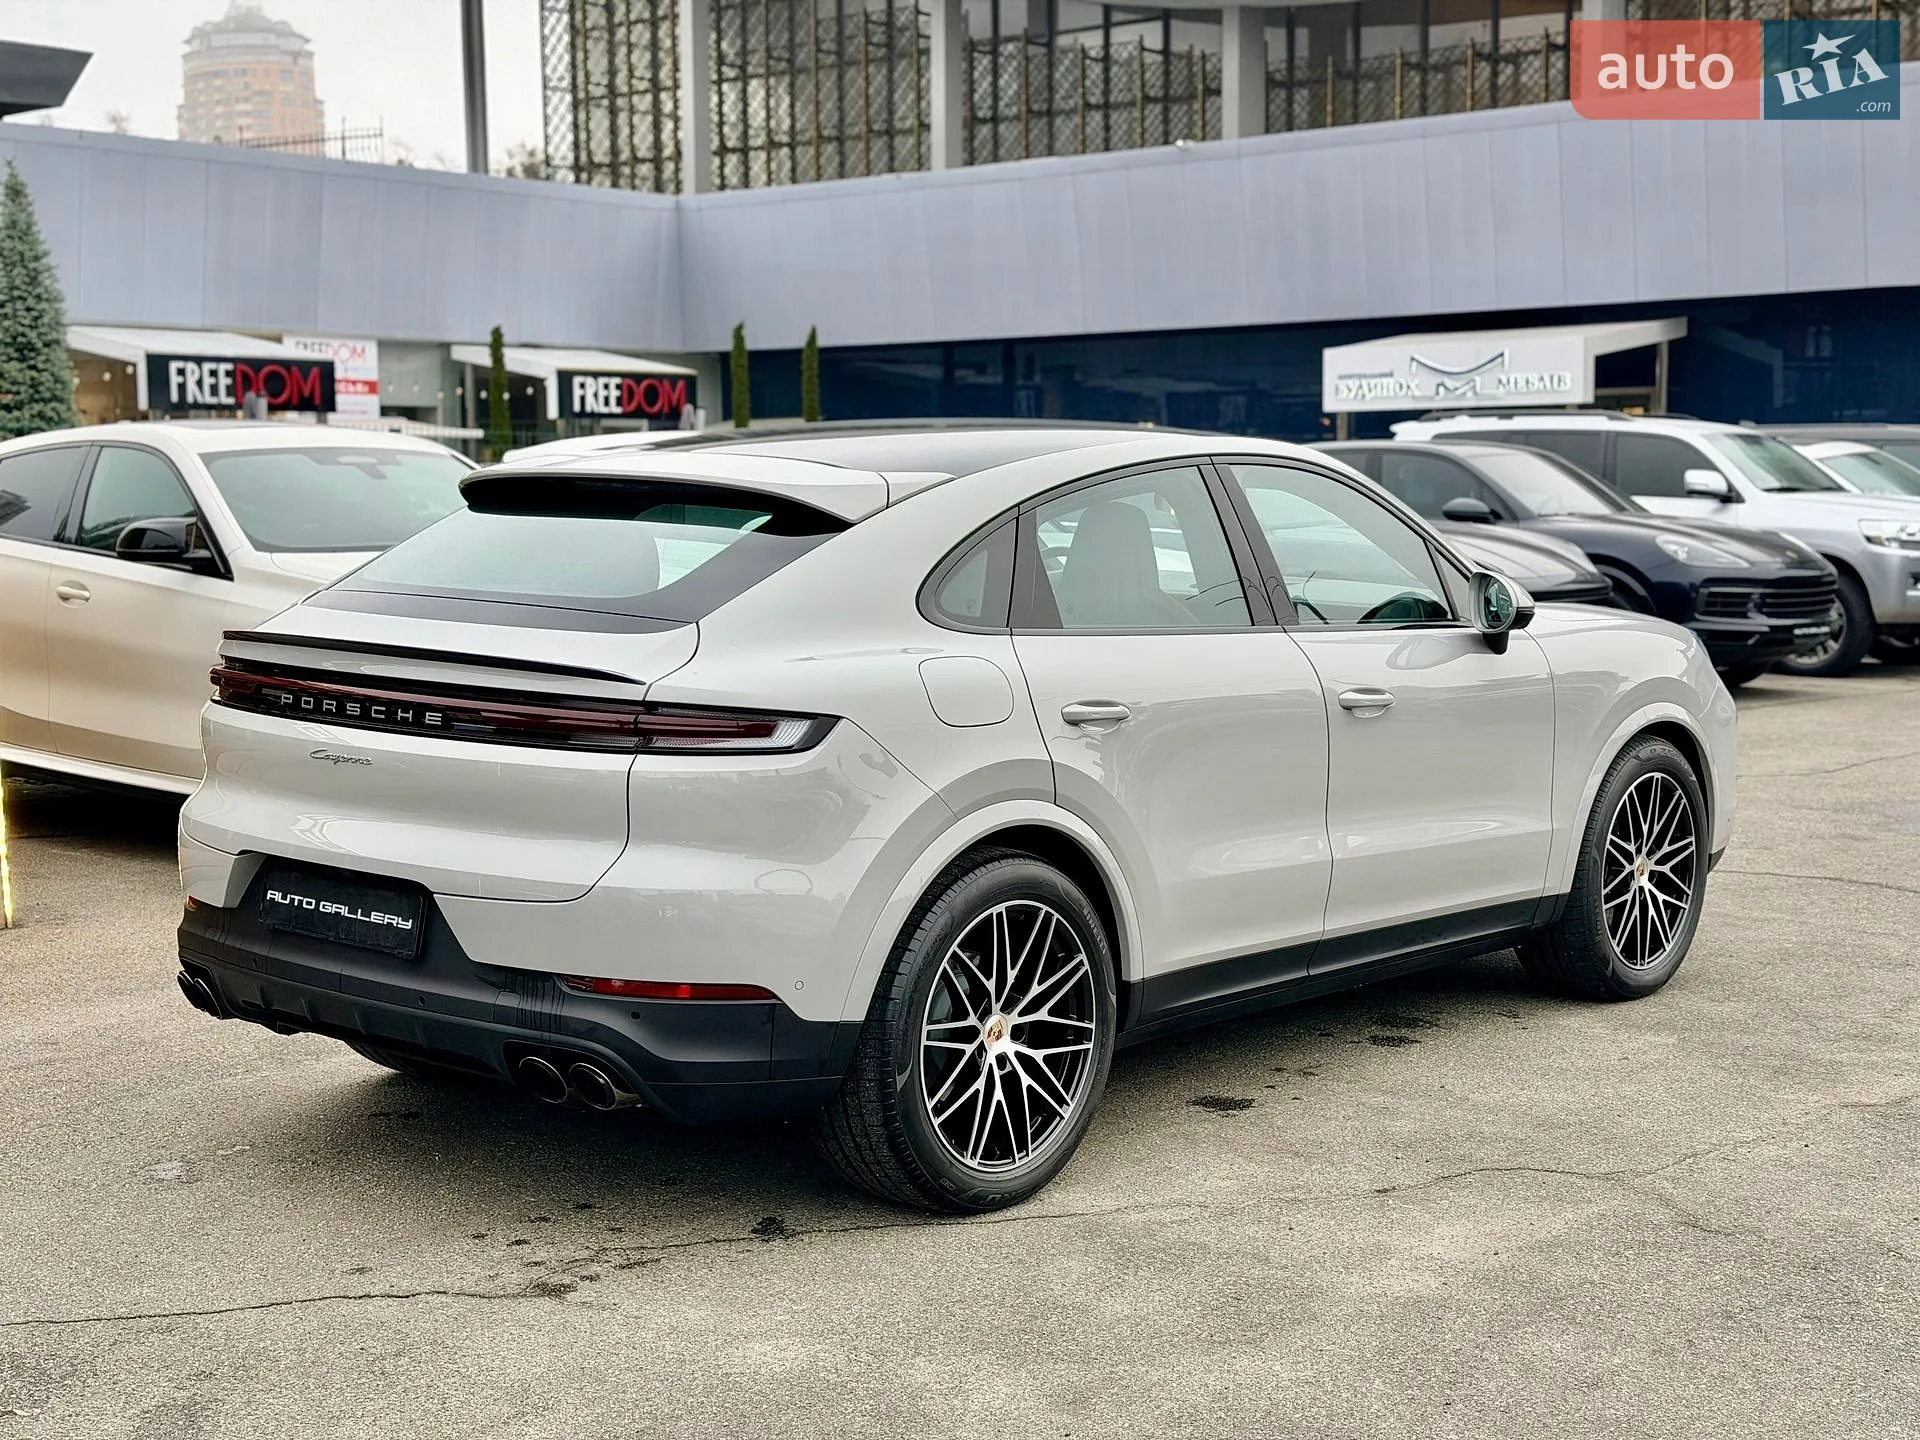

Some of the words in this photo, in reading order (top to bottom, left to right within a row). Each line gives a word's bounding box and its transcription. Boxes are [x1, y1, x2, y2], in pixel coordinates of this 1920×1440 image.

[168, 359, 321, 407] FREEDOM
[572, 375, 688, 416] FREEDOM
[280, 693, 443, 726] PORSCHE
[309, 747, 373, 766] Cayenne
[266, 890, 316, 910] AUTO
[319, 902, 413, 930] GALLERY
